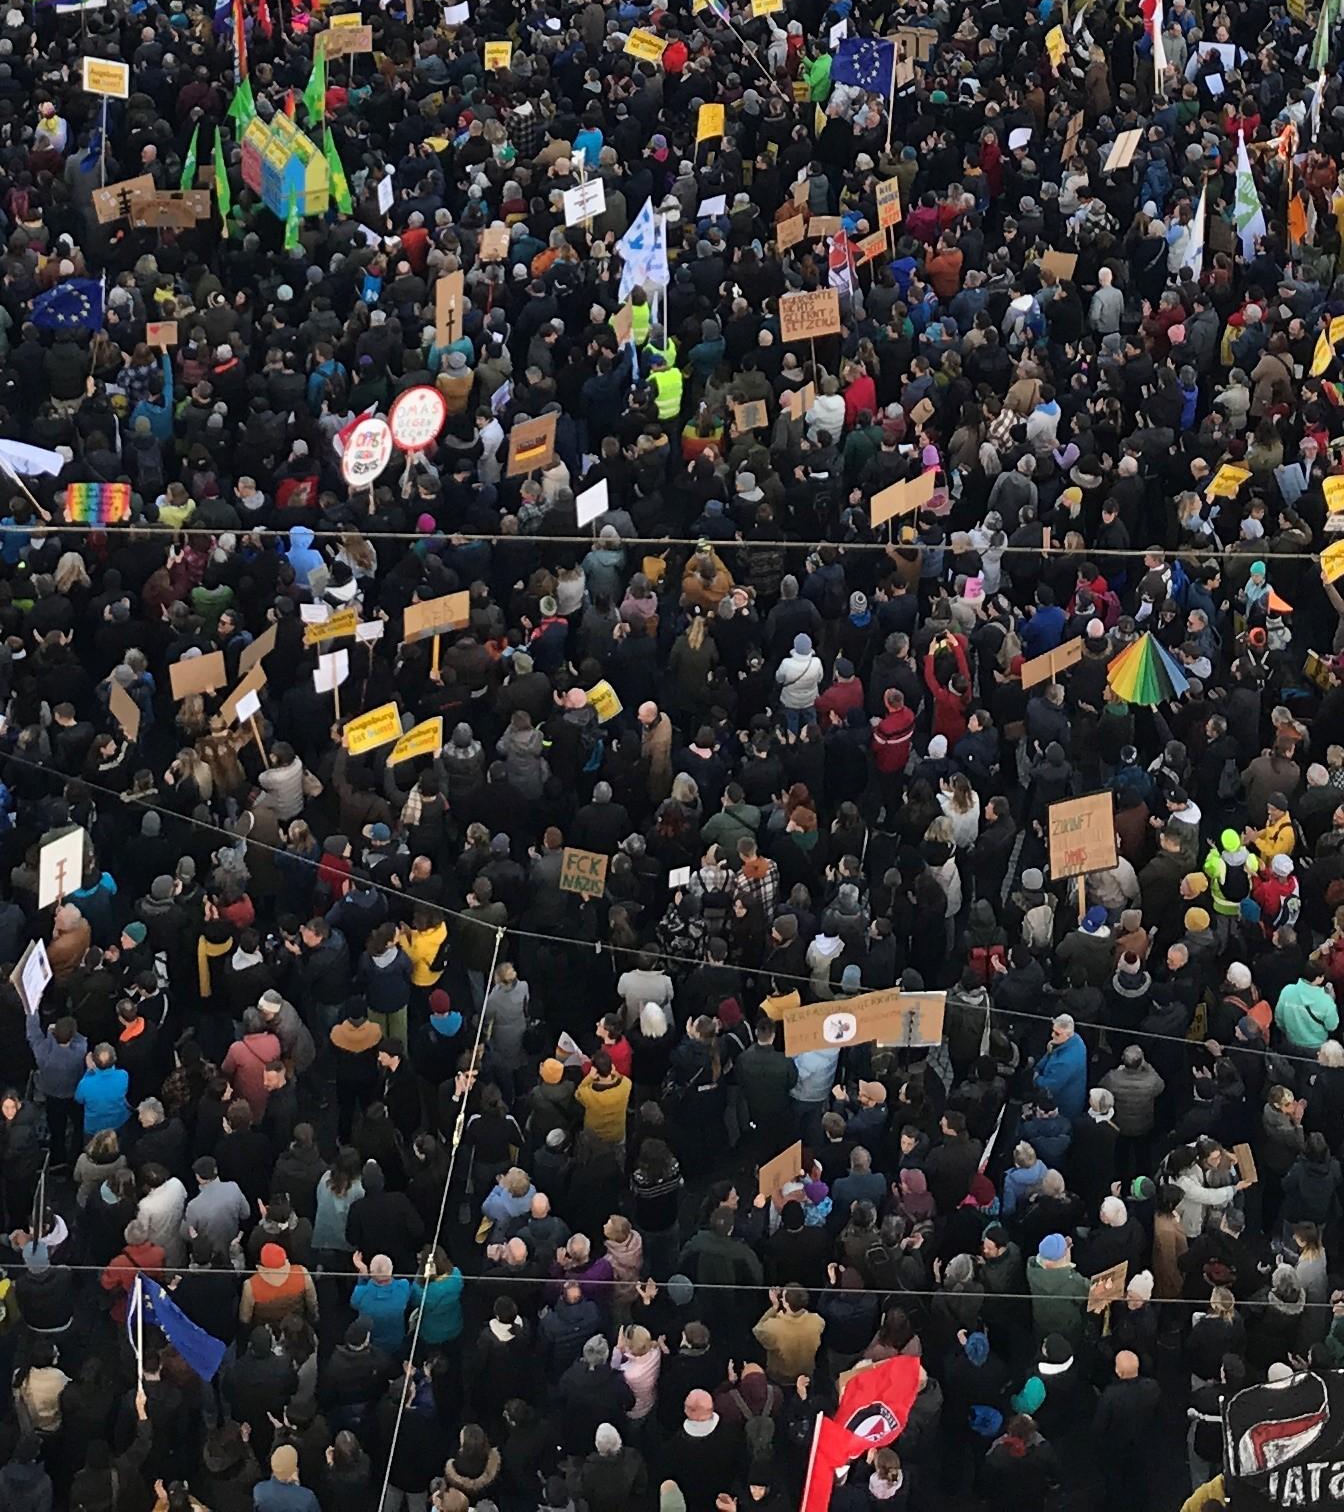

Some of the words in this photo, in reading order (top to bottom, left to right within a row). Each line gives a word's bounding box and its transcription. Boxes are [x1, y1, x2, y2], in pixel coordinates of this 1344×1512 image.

[347, 711, 395, 733] Augsburg
[352, 731, 367, 744] ist
[567, 853, 602, 876] FCK
[562, 874, 603, 894] NAZIS
